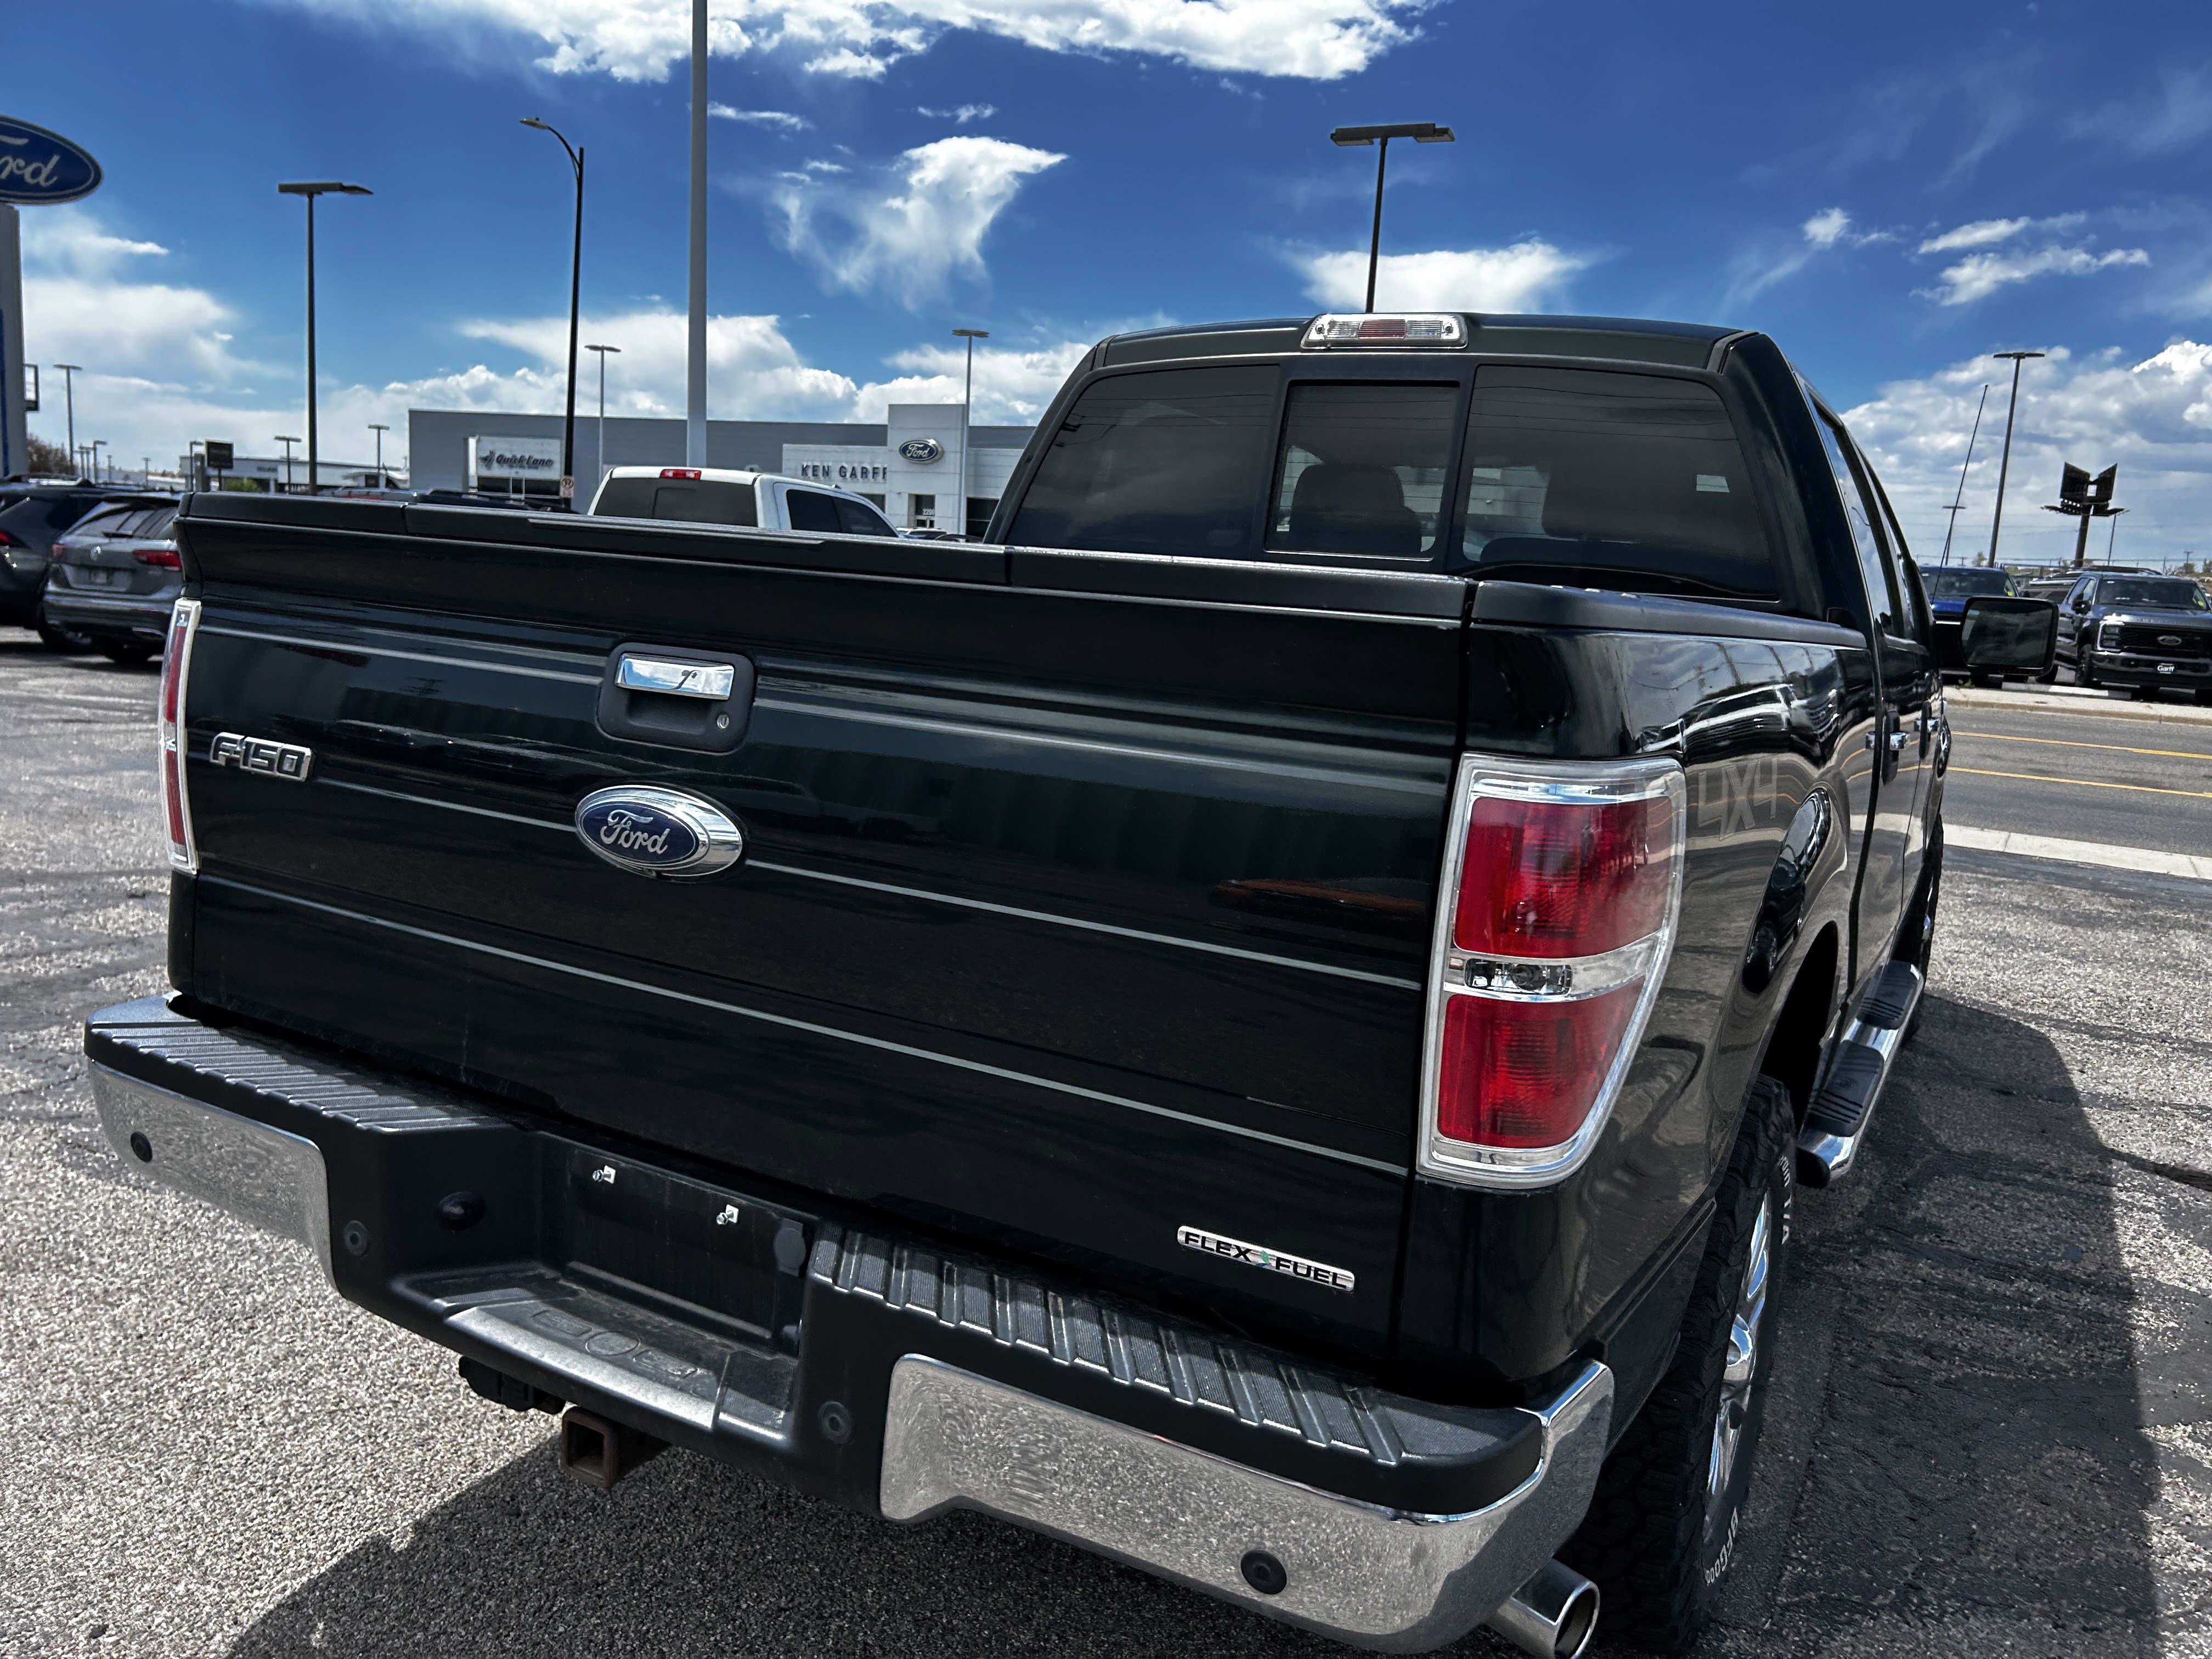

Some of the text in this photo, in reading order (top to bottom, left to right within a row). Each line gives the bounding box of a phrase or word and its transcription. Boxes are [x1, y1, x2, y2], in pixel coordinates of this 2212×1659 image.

[906, 443, 929, 458] Ford
[526, 455, 554, 467] Lane
[801, 465, 830, 477] KEN
[600, 809, 670, 855] Ford
[1184, 1231, 1347, 1289] FLEX FUEL
